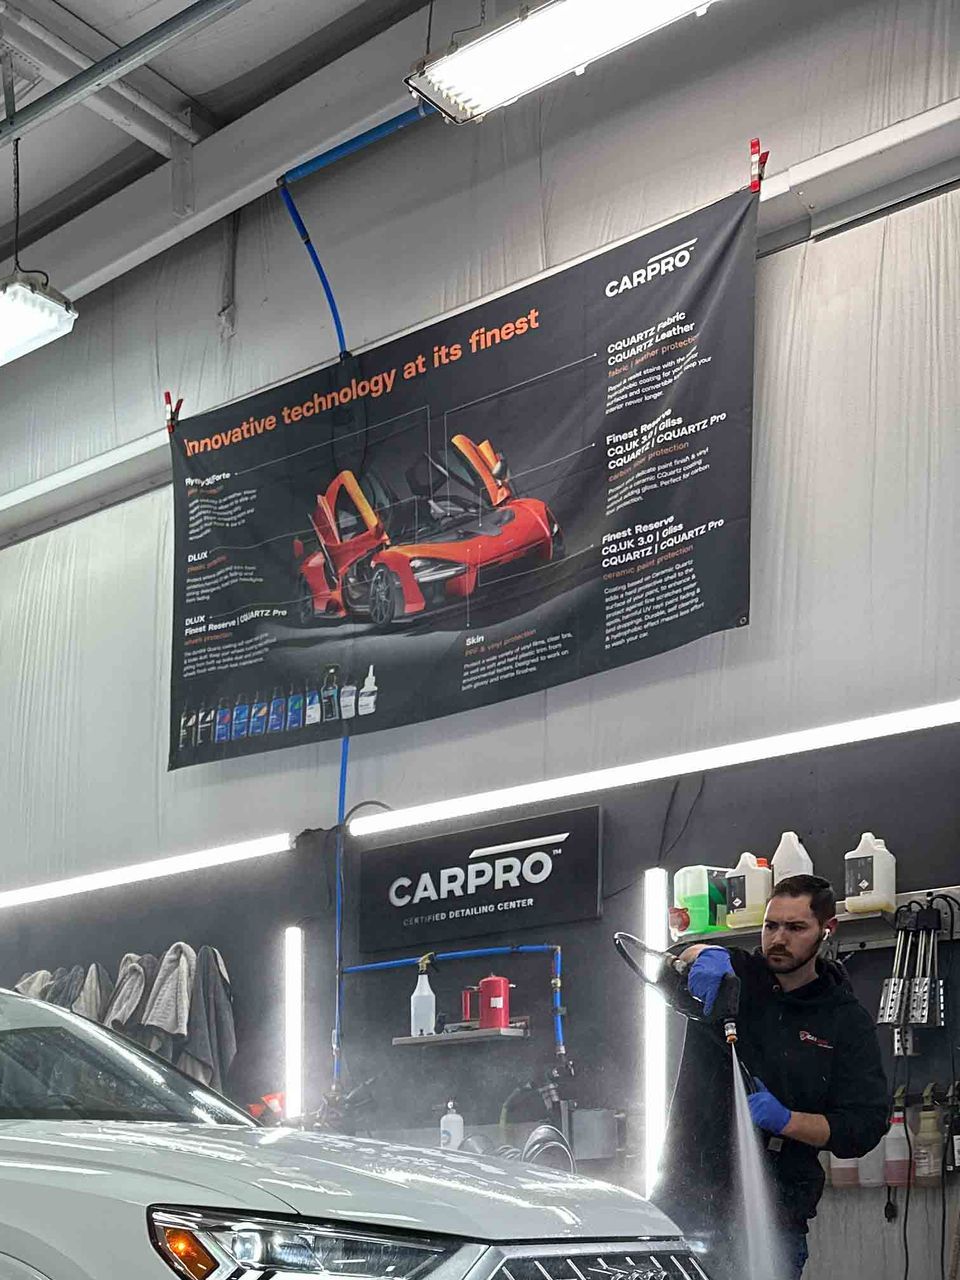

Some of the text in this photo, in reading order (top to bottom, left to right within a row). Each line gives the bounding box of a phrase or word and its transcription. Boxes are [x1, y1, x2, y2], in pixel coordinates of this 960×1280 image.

[605, 250, 690, 298] CARPRO
[607, 311, 686, 354] CQUARTZ Fabric
[608, 322, 695, 366] CQUARTZ Leather
[662, 360, 675, 369] with
[698, 356, 712, 365] your
[184, 309, 539, 456] Innovative technology at its finest
[639, 374, 661, 385] coating
[606, 408, 672, 444] Finest Reserve
[607, 439, 639, 457] CQ.UK
[659, 417, 683, 430] Gliss
[608, 442, 650, 469] CQUARTZ
[656, 419, 708, 443] CQUARTZ
[710, 412, 726, 425] Pro
[648, 442, 689, 461] protection
[660, 476, 682, 486] Perfect
[602, 516, 674, 544] Finest Reserve
[602, 539, 635, 555] CQ.UK
[638, 534, 653, 546] 3.0
[662, 523, 684, 538] Gliss
[602, 546, 652, 568] CQUARTZ
[660, 526, 706, 550] CQUARTZ
[708, 519, 725, 531] Pro
[188, 550, 208, 562] DLUX
[603, 545, 693, 580] ceramic paint protection
[185, 615, 205, 626] DLUX
[185, 625, 206, 636] Finest
[208, 620, 235, 631] Reserve
[466, 635, 484, 645] Skin
[389, 852, 552, 907] CARPRO
[403, 899, 534, 926] CERTIFIED DETAILING CENTER
